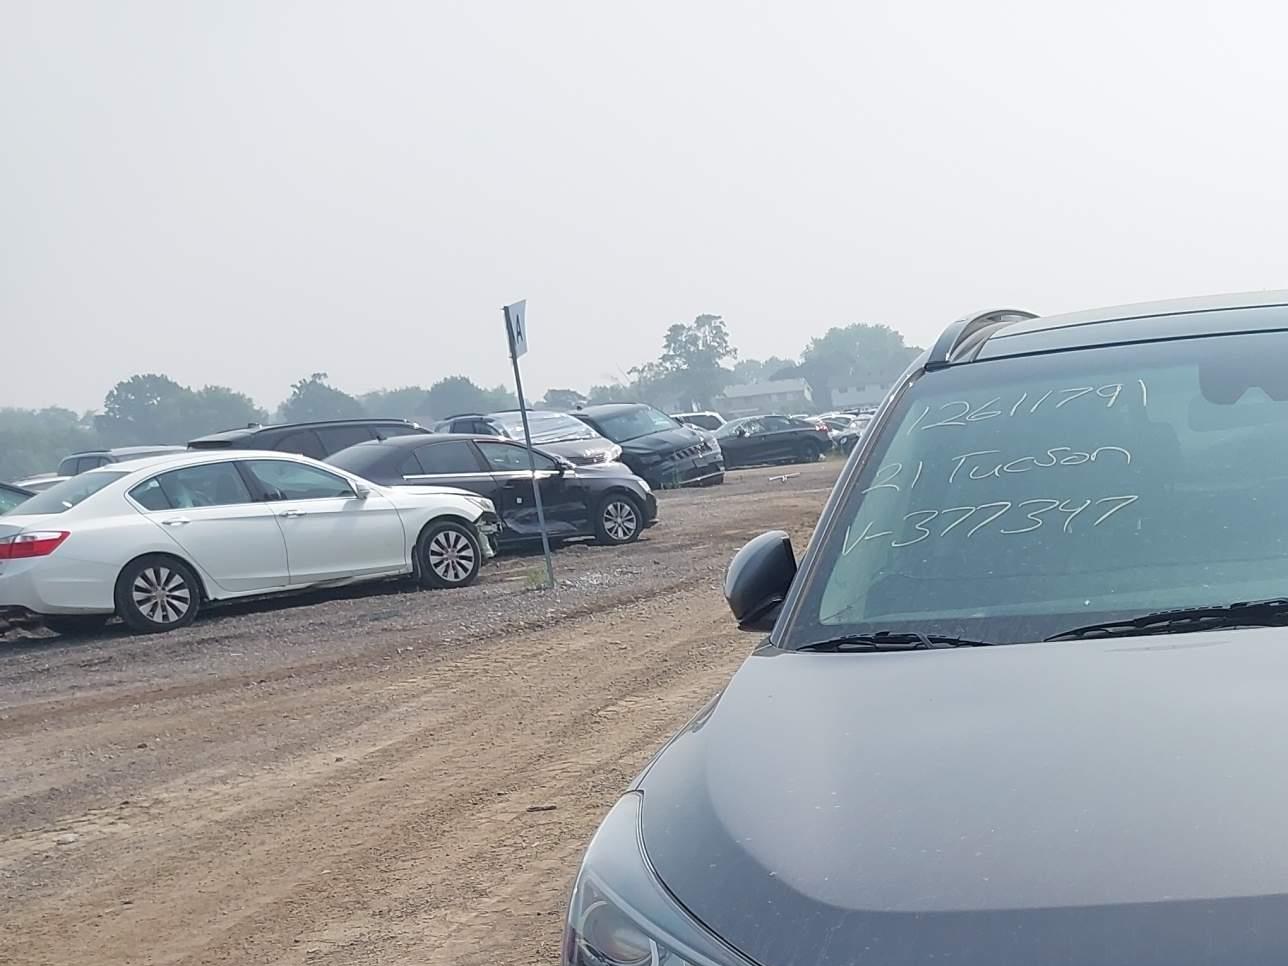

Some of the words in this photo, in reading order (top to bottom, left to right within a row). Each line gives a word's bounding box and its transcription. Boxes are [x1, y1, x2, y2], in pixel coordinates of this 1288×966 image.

[515, 313, 524, 345] A
[907, 379, 1148, 435] 12611791
[861, 460, 924, 494] 21
[947, 446, 1131, 484] Tucson
